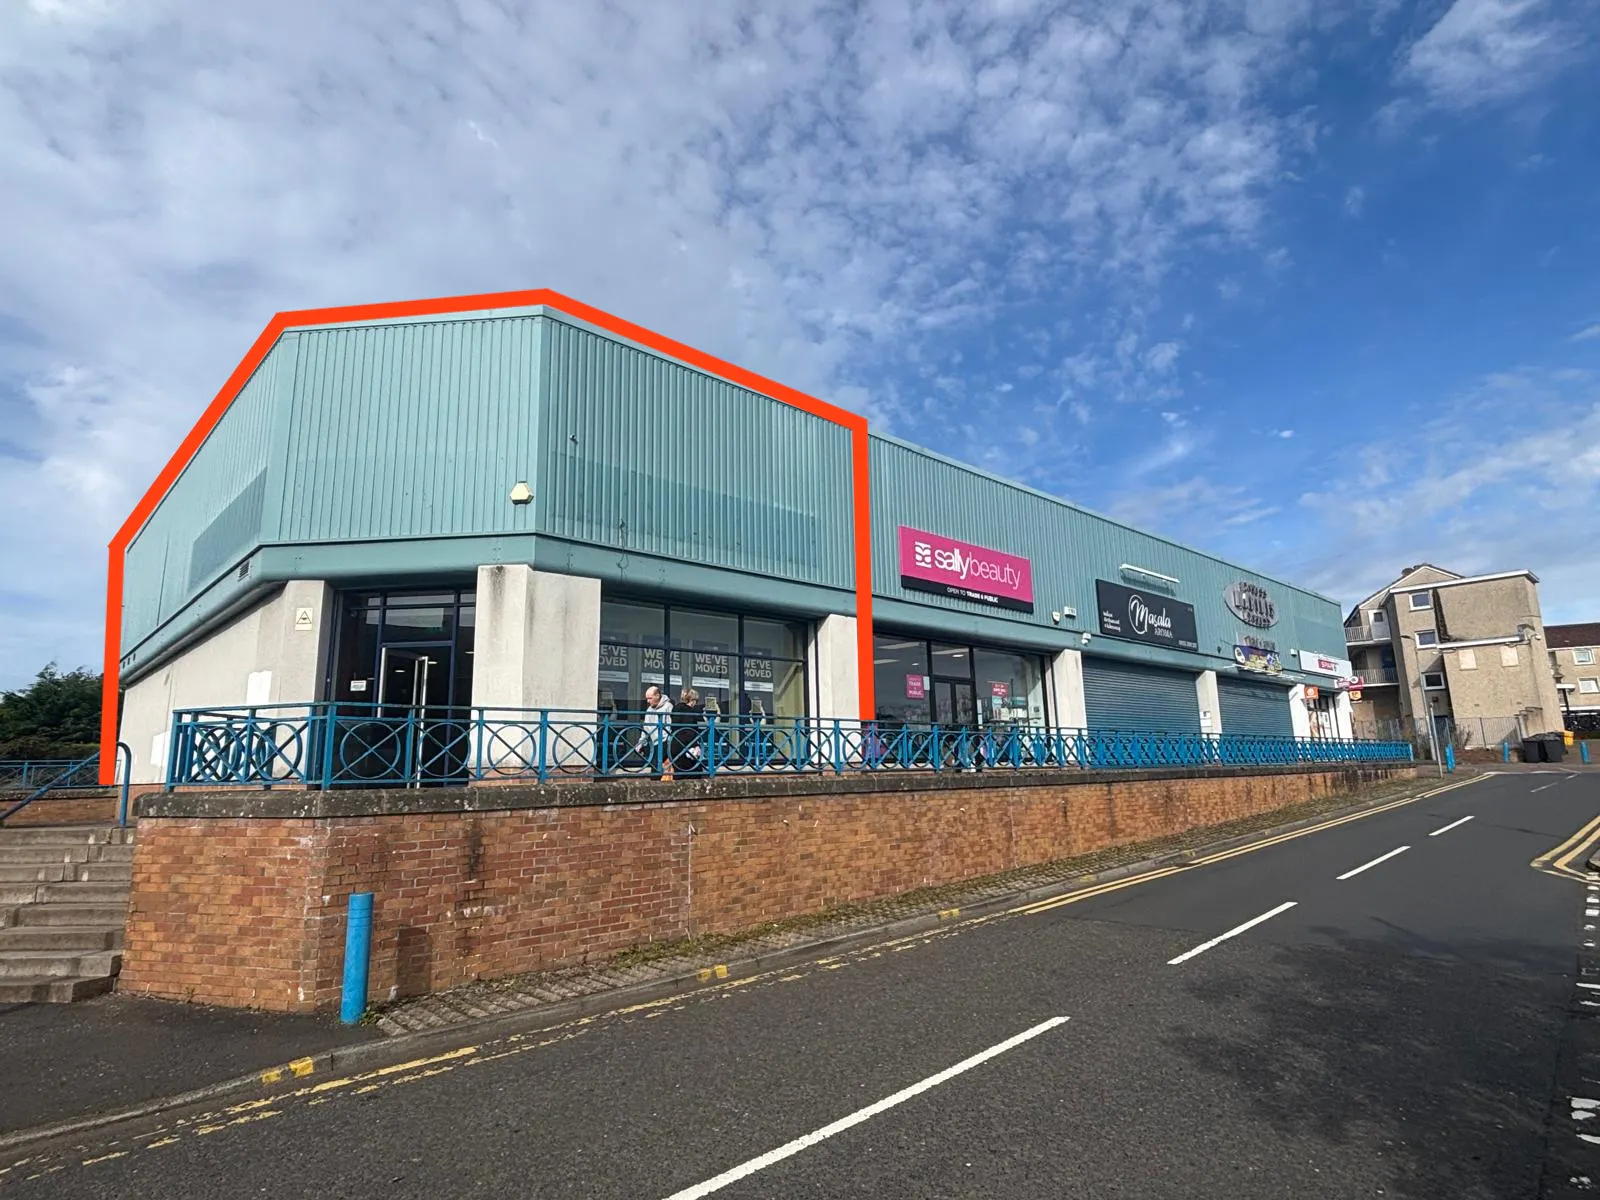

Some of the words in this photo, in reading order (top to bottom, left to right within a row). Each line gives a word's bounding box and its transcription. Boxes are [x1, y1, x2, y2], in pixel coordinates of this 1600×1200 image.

[1130, 598, 1171, 633] Masala
[599, 645, 627, 657] E'VE
[599, 656, 627, 667] OVED
[695, 653, 728, 665] WE'VE
[695, 663, 728, 674] MOVED
